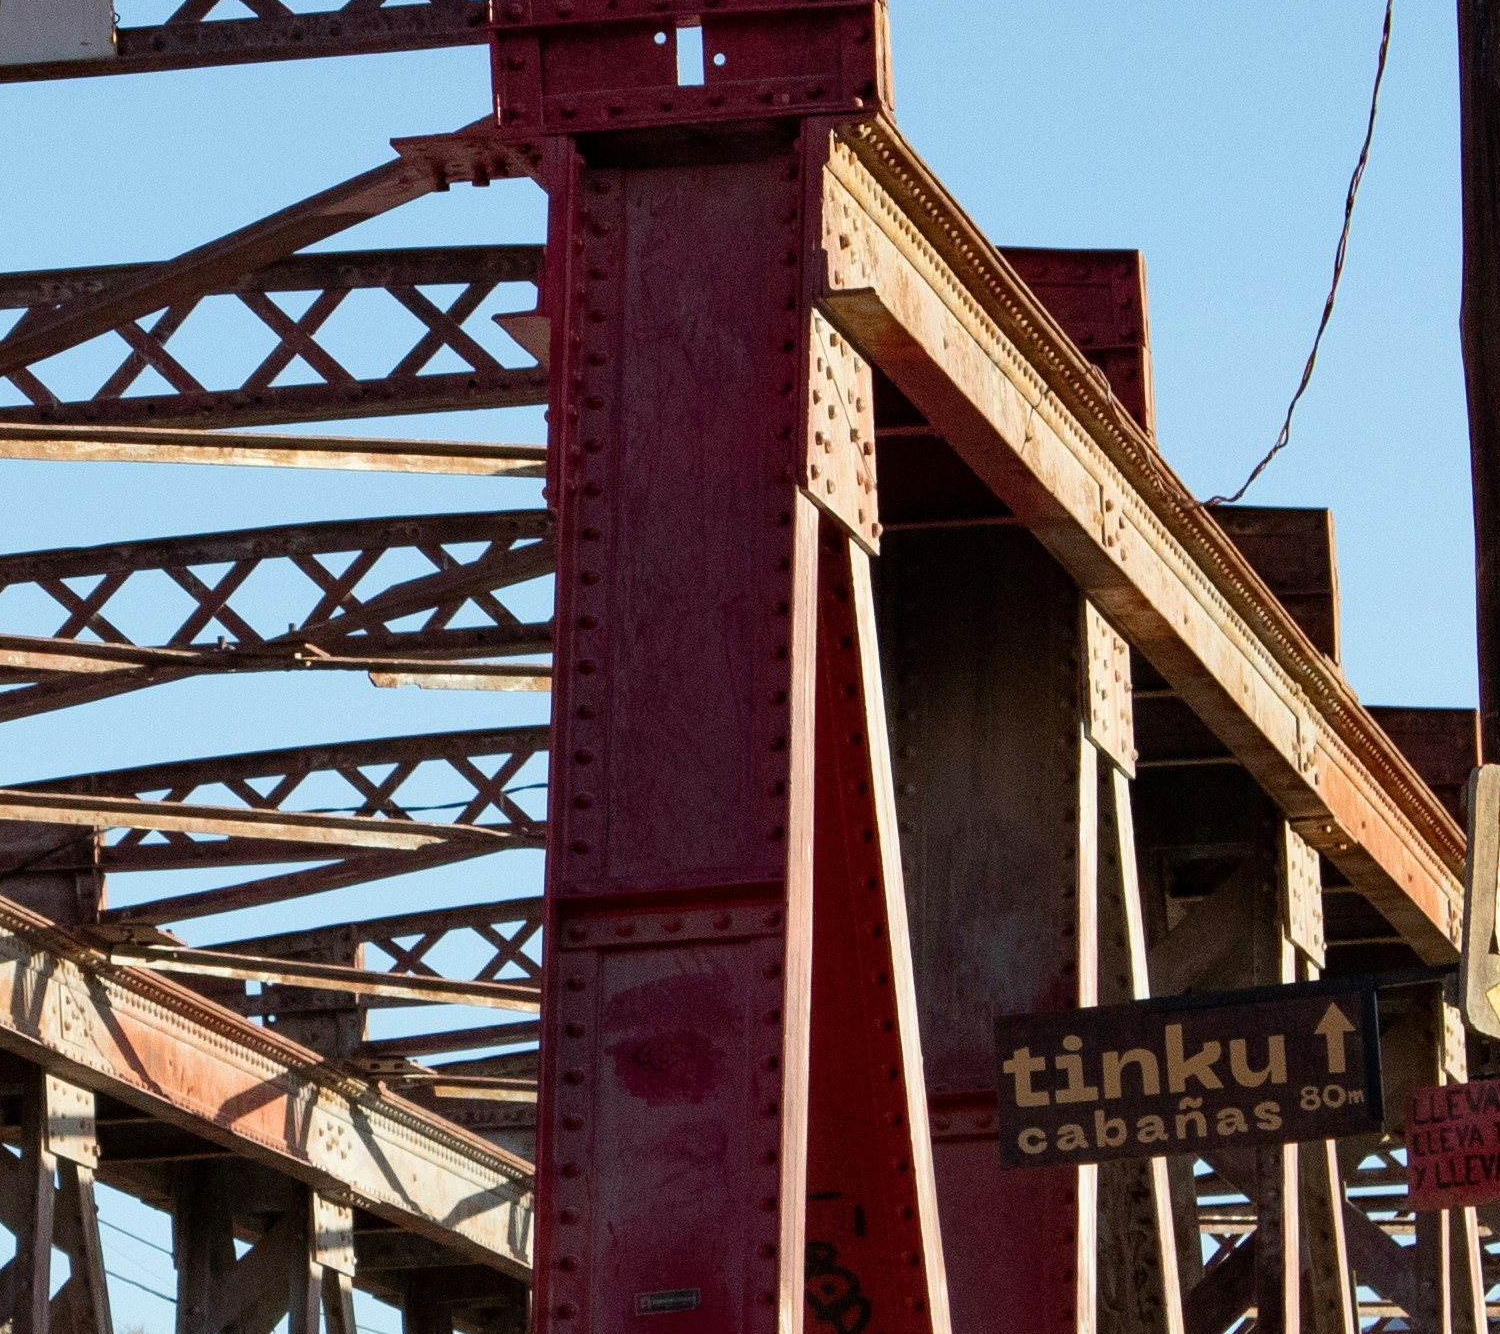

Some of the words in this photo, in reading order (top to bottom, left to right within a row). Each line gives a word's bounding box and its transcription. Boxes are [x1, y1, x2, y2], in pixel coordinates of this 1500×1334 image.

[1003, 1023, 1288, 1108] tinku
[1299, 1083, 1365, 1112] 80m
[1411, 1087, 1500, 1126] LLEVA
[1017, 1096, 1284, 1156] cabañas
